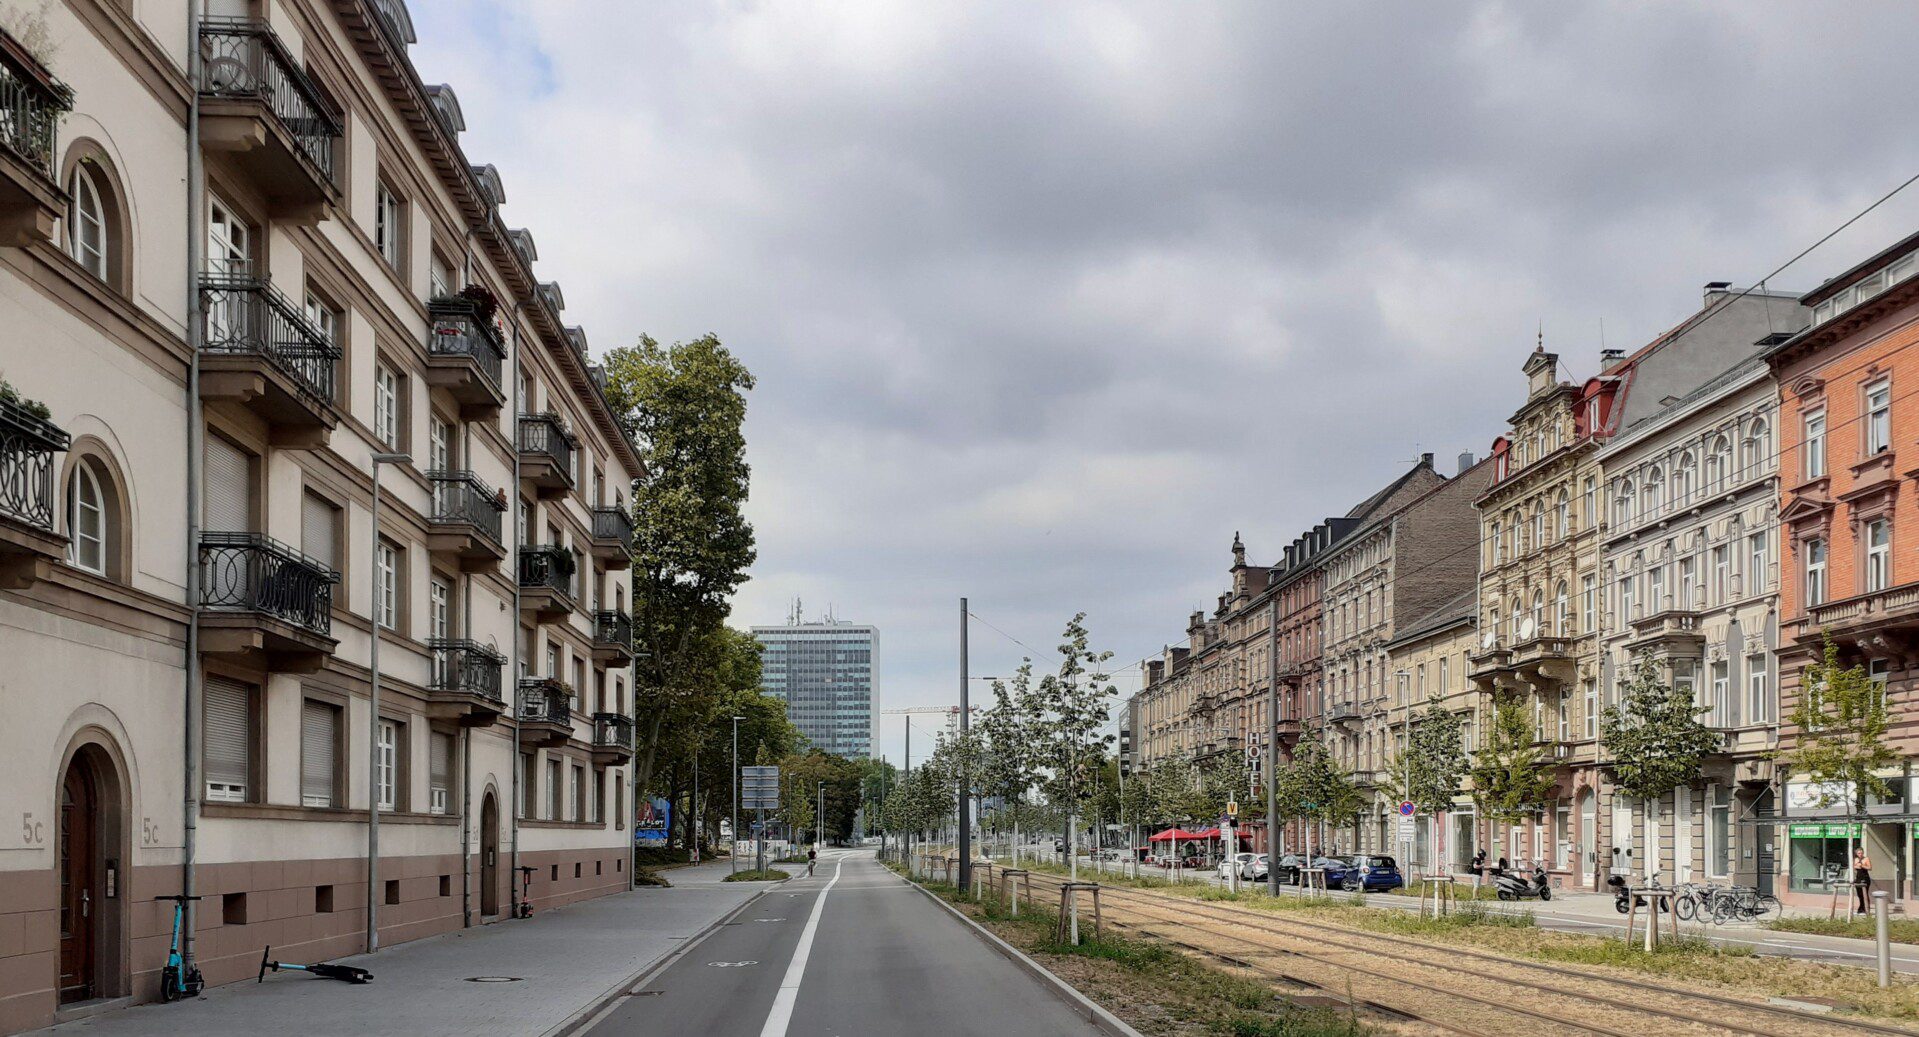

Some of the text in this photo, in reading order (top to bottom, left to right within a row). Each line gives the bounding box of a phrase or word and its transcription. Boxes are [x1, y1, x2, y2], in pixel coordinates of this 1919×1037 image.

[1248, 732, 1261, 798] HOTEL
[23, 812, 43, 844] 5c
[143, 817, 159, 844] 5c
